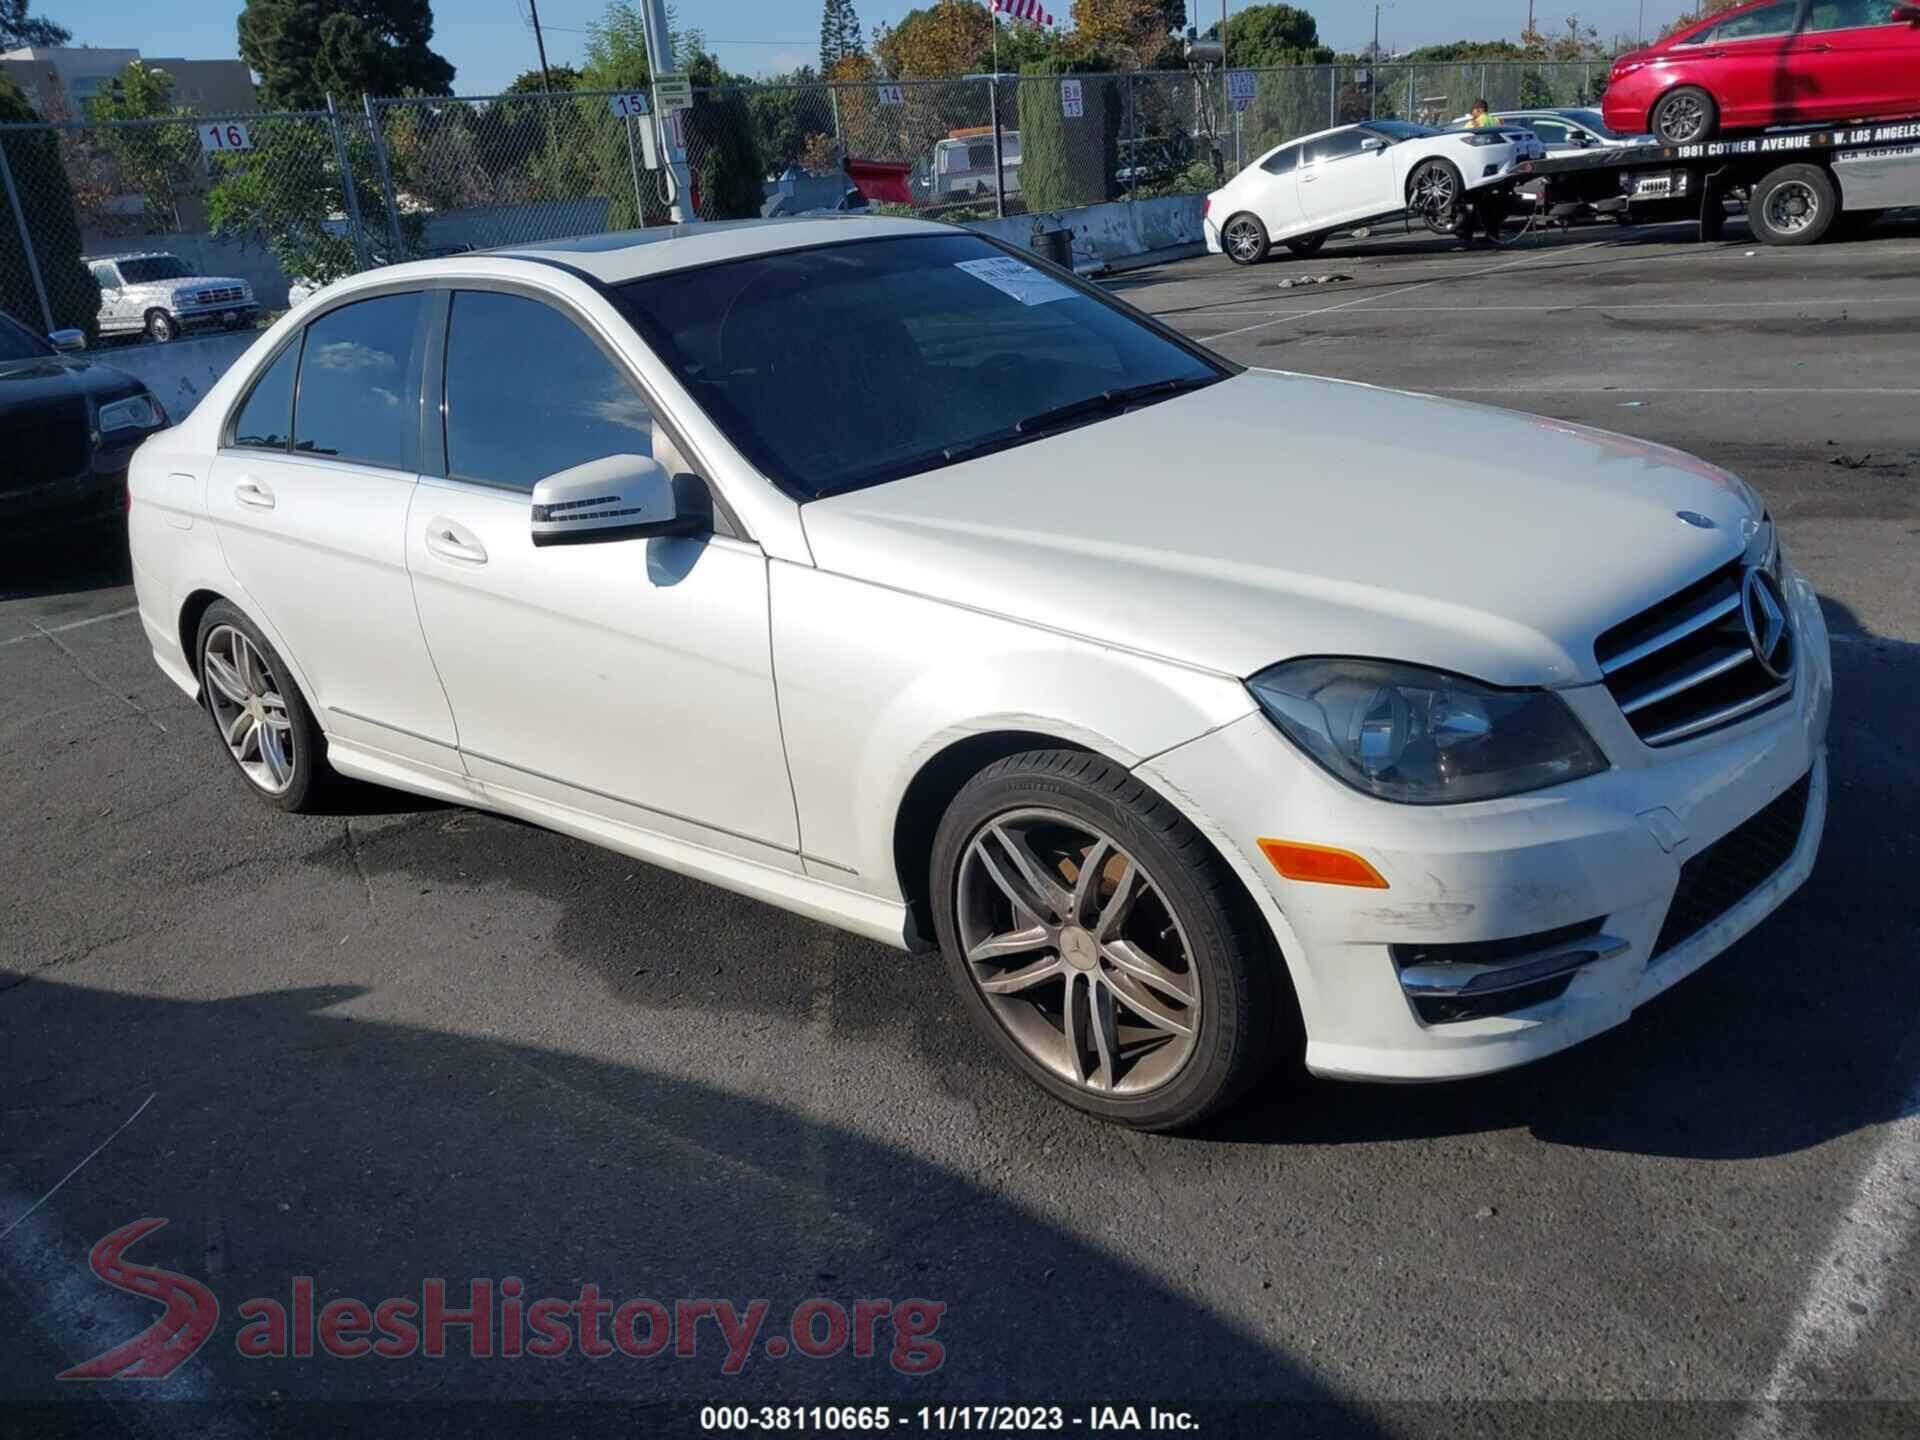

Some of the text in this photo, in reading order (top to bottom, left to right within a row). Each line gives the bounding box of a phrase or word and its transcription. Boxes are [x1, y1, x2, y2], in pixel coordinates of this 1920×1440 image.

[618, 95, 643, 115] 15
[883, 87, 900, 102] 14
[209, 125, 243, 148] 16
[1677, 144, 1704, 158] 1981
[1760, 135, 1812, 152] AVENUE
[1833, 131, 1847, 145] W.
[1850, 129, 1871, 143] LOS
